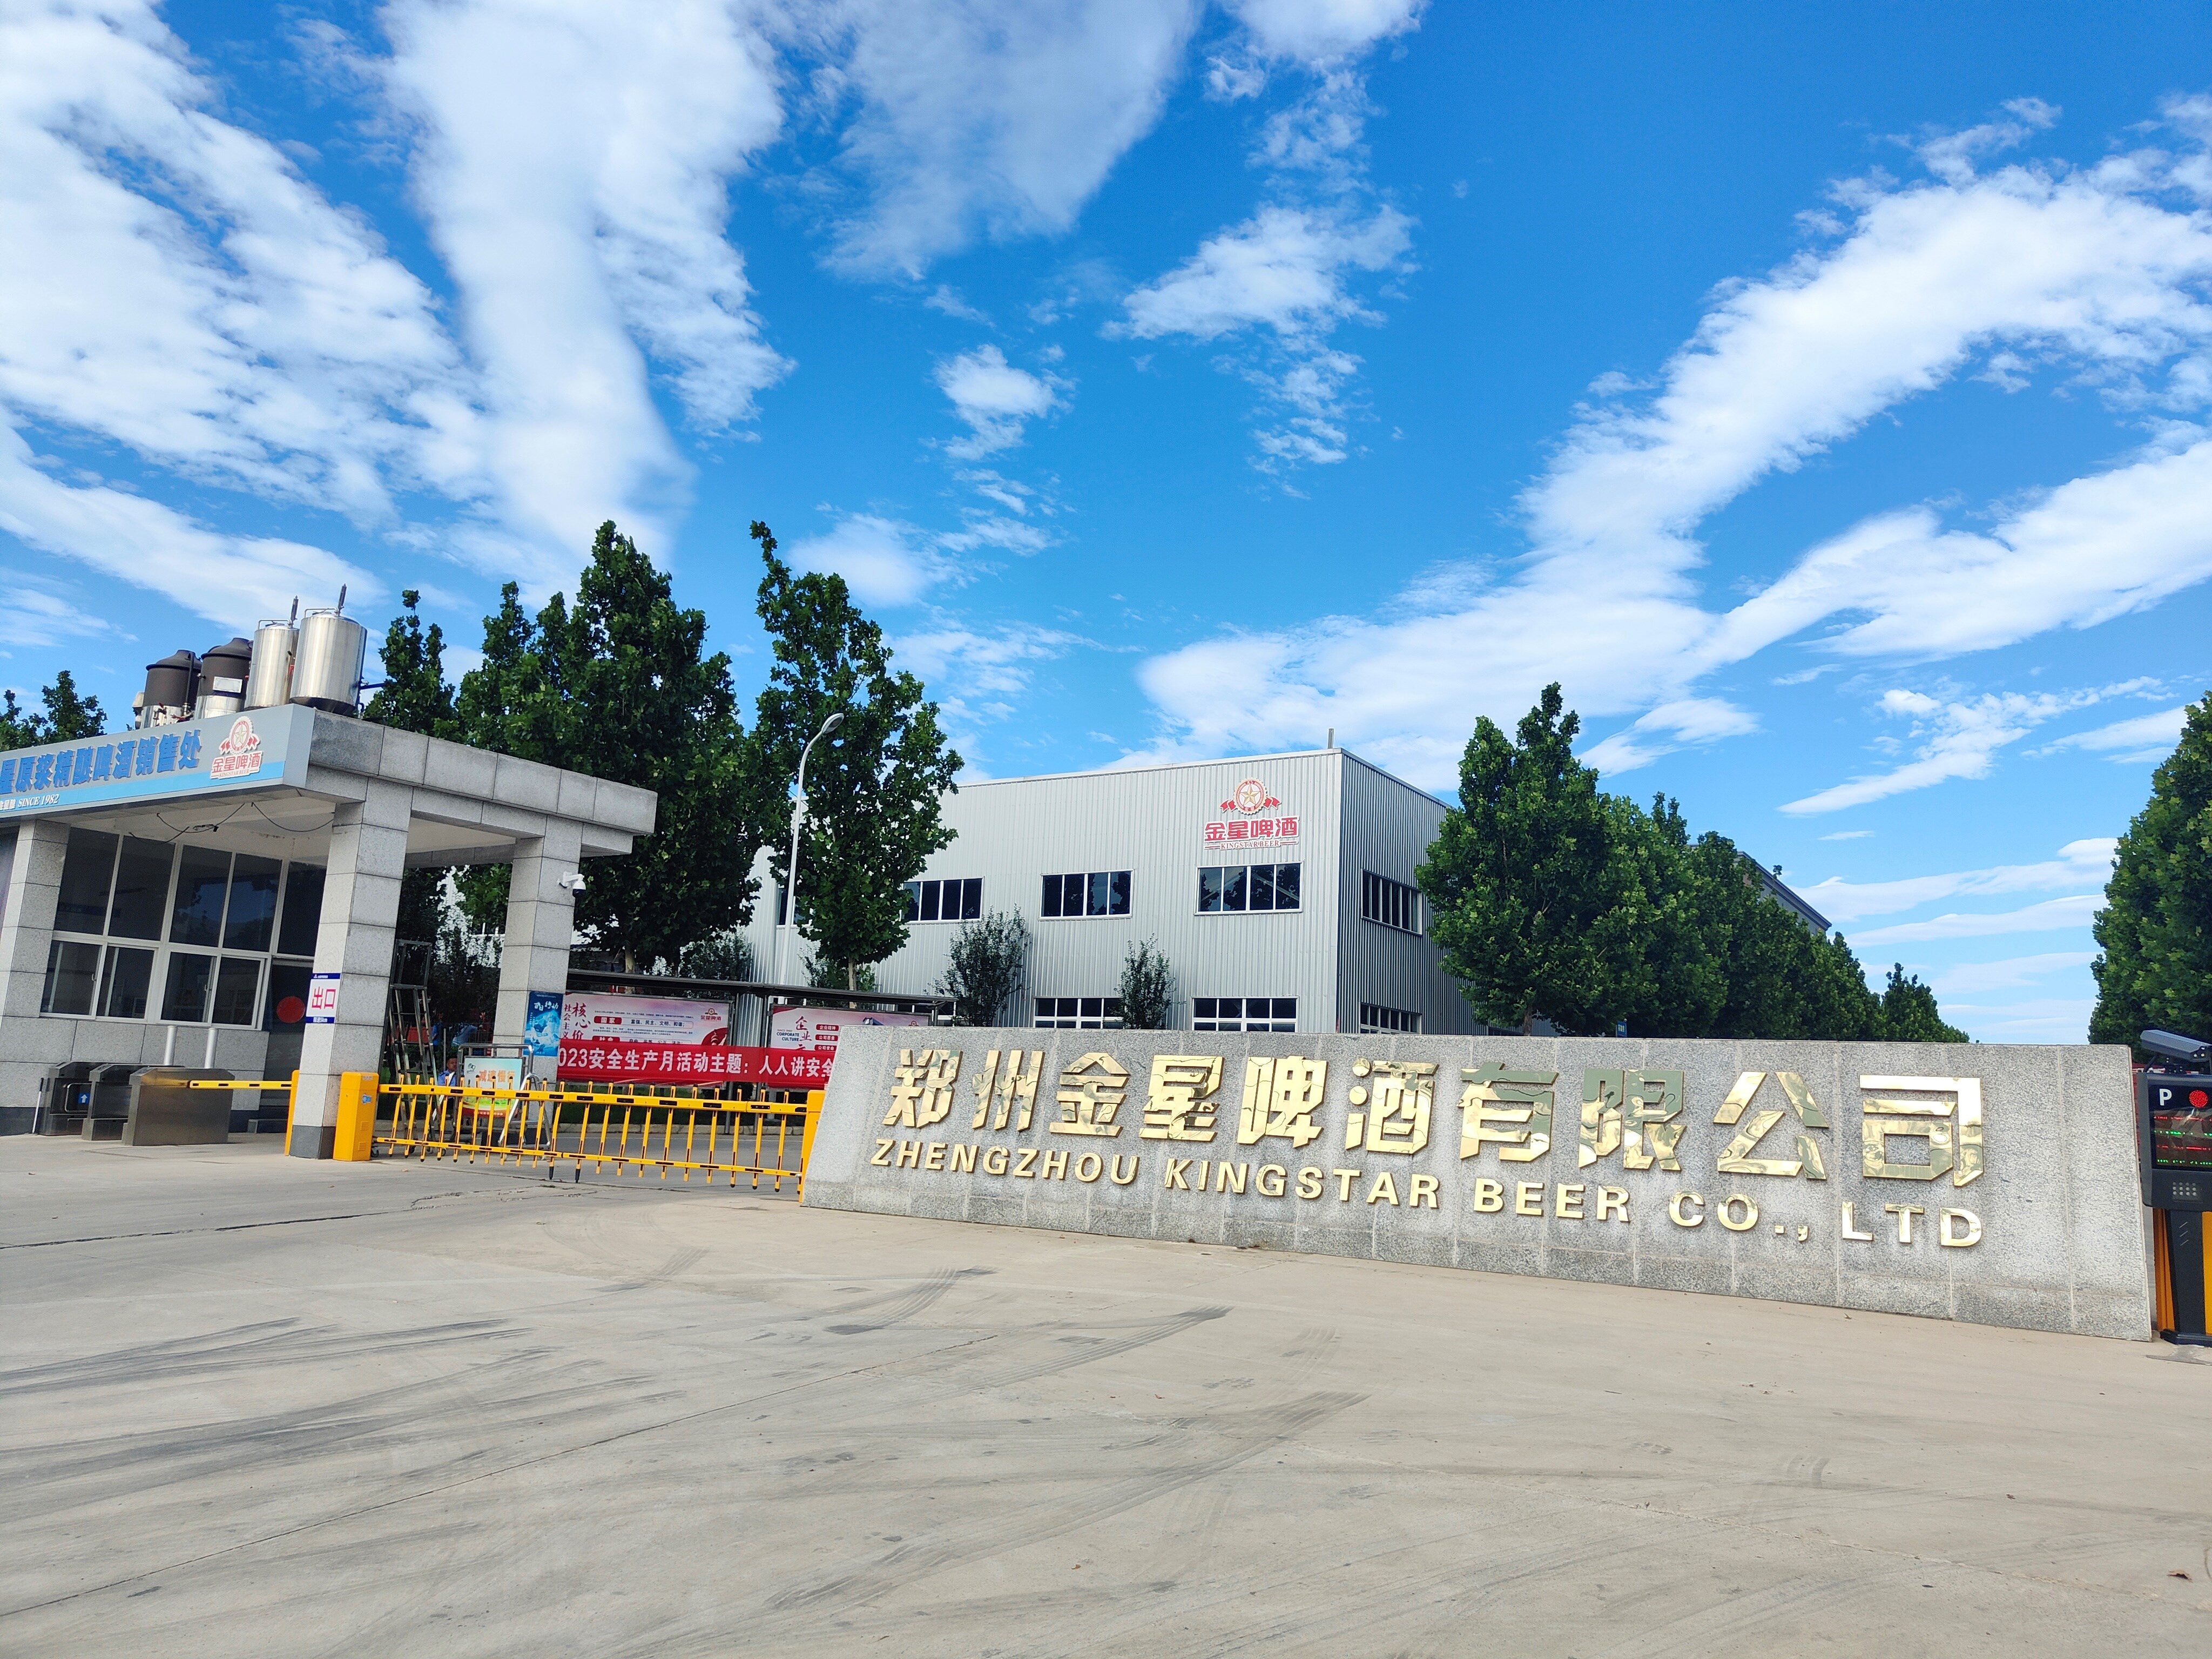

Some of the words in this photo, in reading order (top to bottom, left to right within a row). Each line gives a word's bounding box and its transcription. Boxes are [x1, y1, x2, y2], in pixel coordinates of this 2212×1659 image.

[212, 752, 261, 773] 金星啤酒
[18, 796, 41, 807] SINCE
[42, 793, 59, 805] 1982
[1204, 817, 1298, 841] 金星啤酒
[312, 987, 336, 1009] 出口
[562, 1003, 572, 1039] 社会主义
[2159, 1088, 2172, 1106] P
[882, 1048, 1985, 1187] 郑州金星啤酒有限公司
[870, 1138, 1140, 1185] ZHENGZHOU
[1164, 1158, 1440, 1209] KINGSTAR
[1473, 1177, 1630, 1222] BEER
[1669, 1190, 1810, 1242] CO.,
[1841, 1201, 1984, 1247] LTD
